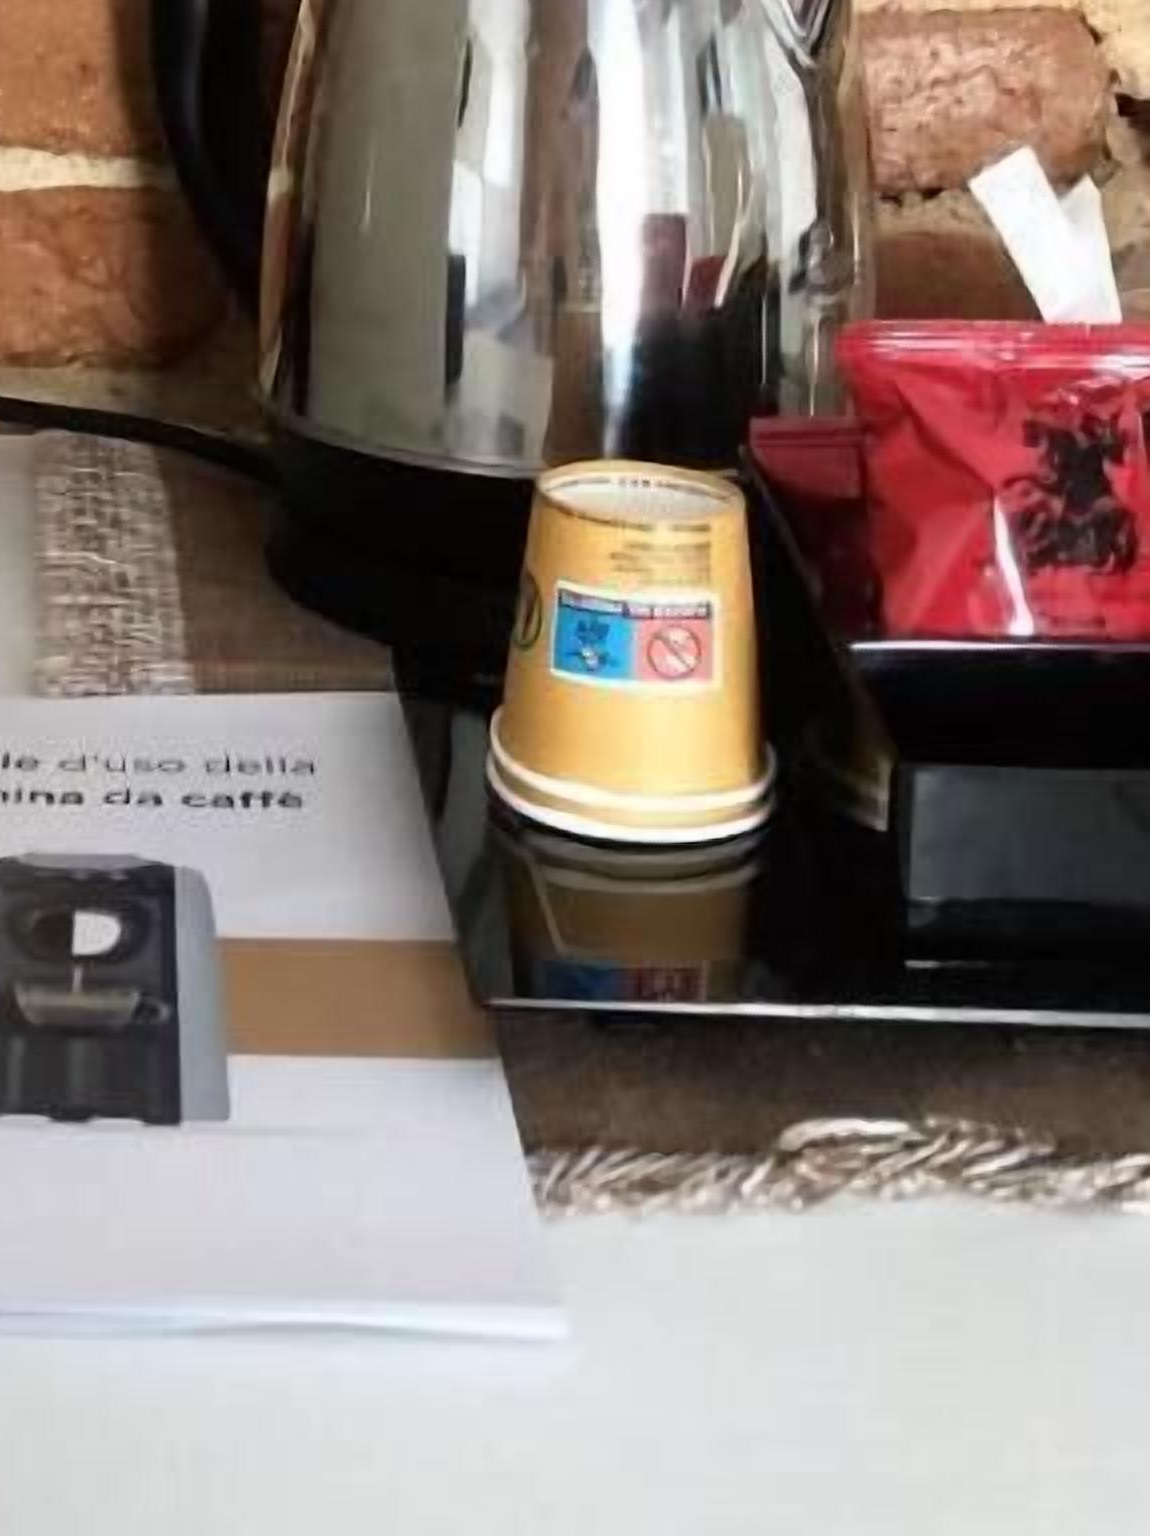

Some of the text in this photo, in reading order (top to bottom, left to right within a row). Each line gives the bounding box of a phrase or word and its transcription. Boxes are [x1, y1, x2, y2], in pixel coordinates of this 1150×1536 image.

[57, 753, 186, 773] d'uso
[206, 750, 316, 775] della
[103, 786, 164, 806] da
